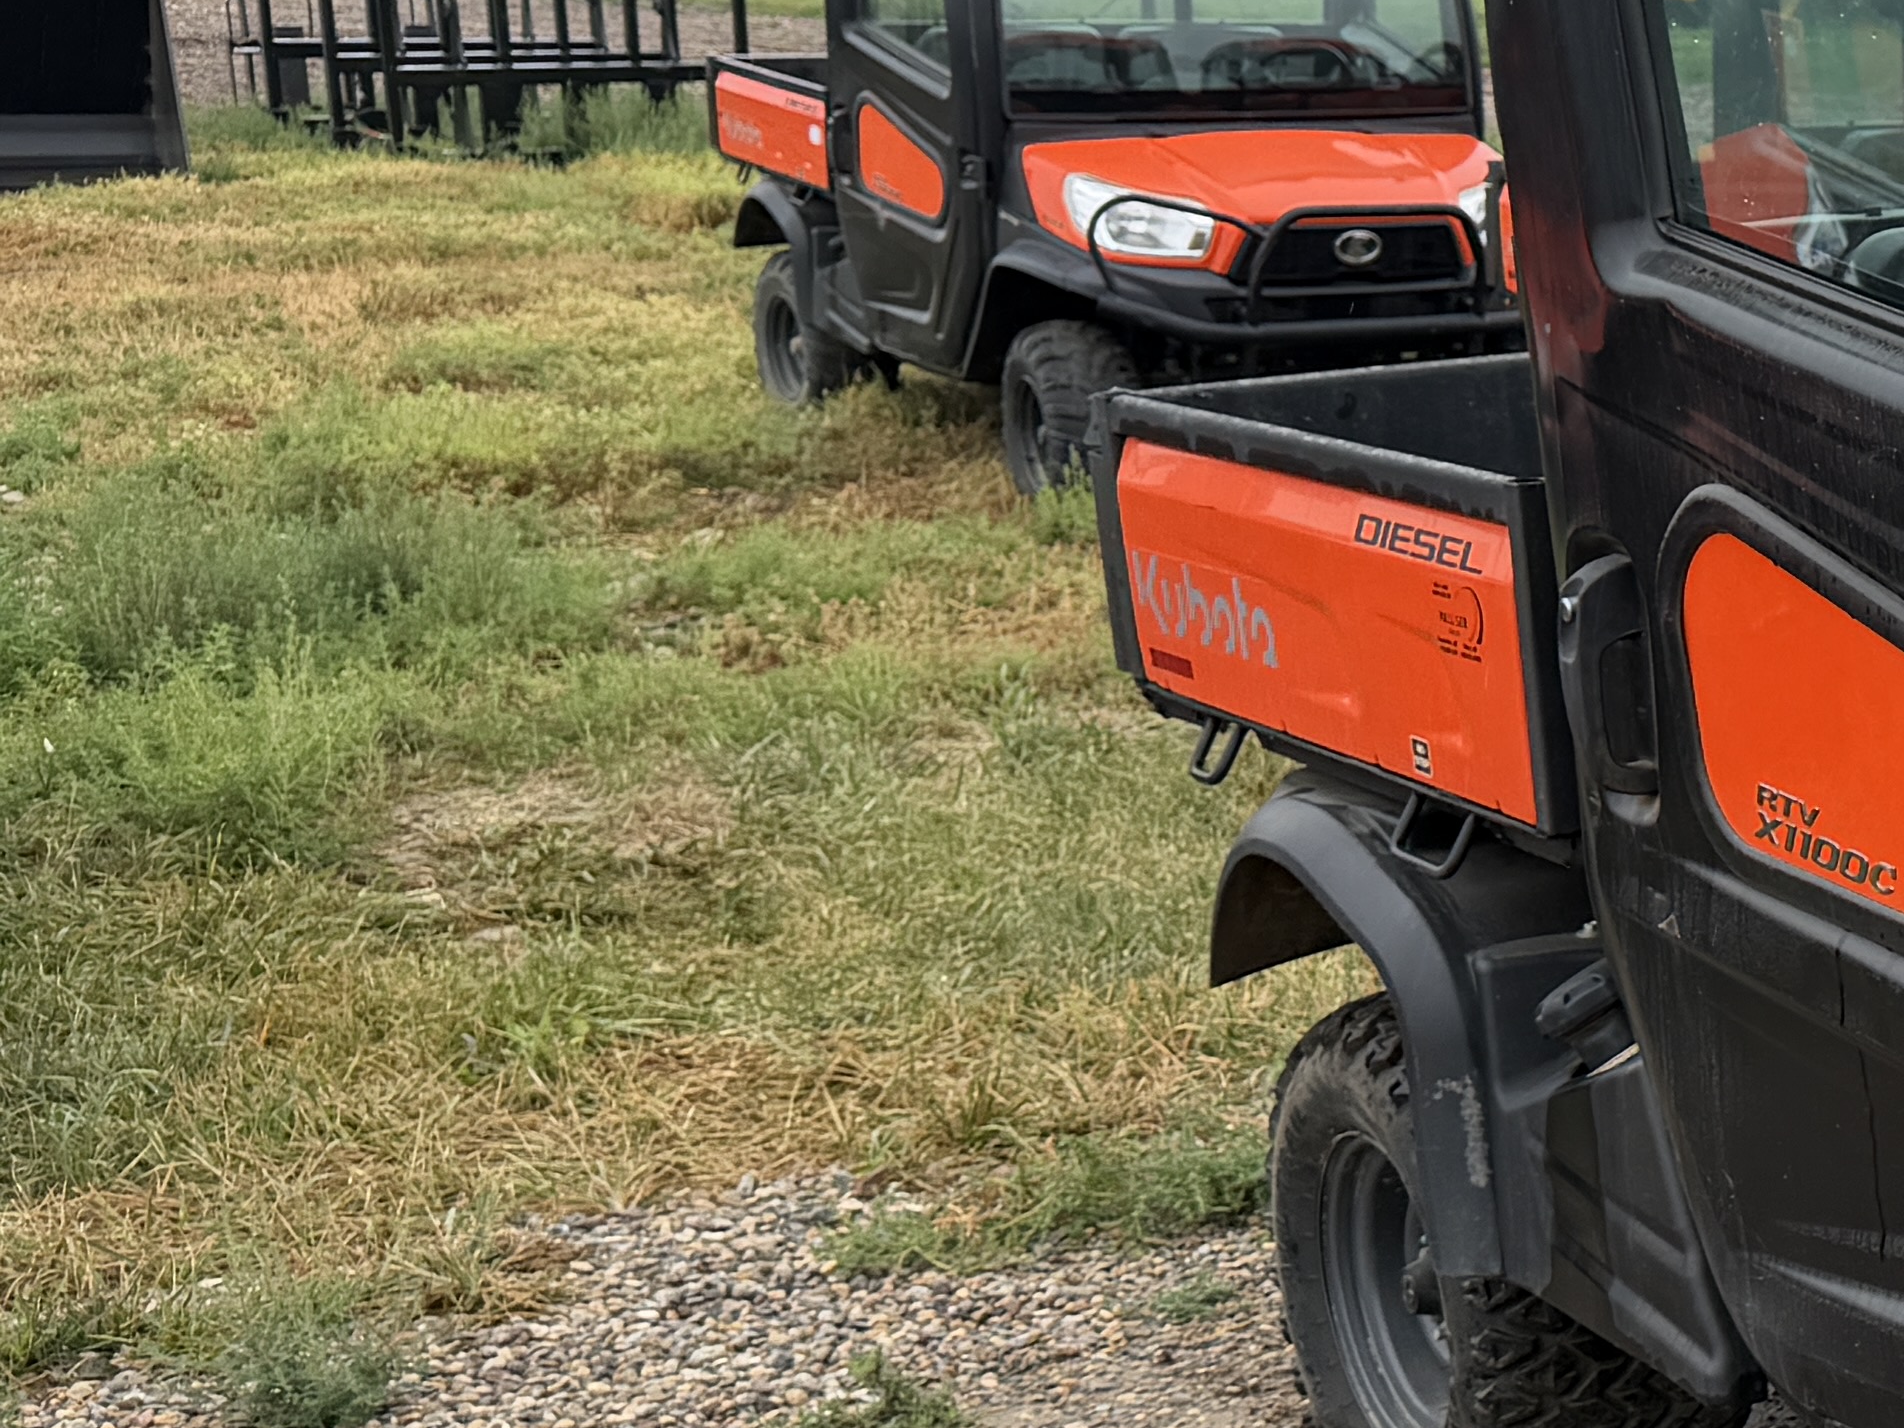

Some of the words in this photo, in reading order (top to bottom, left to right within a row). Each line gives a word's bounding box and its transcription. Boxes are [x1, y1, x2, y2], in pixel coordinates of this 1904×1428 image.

[1354, 513, 1483, 575] DIESEL
[1132, 549, 1279, 669] Kubota
[1756, 782, 1821, 829] RTV
[1754, 809, 1898, 896] X1100C
